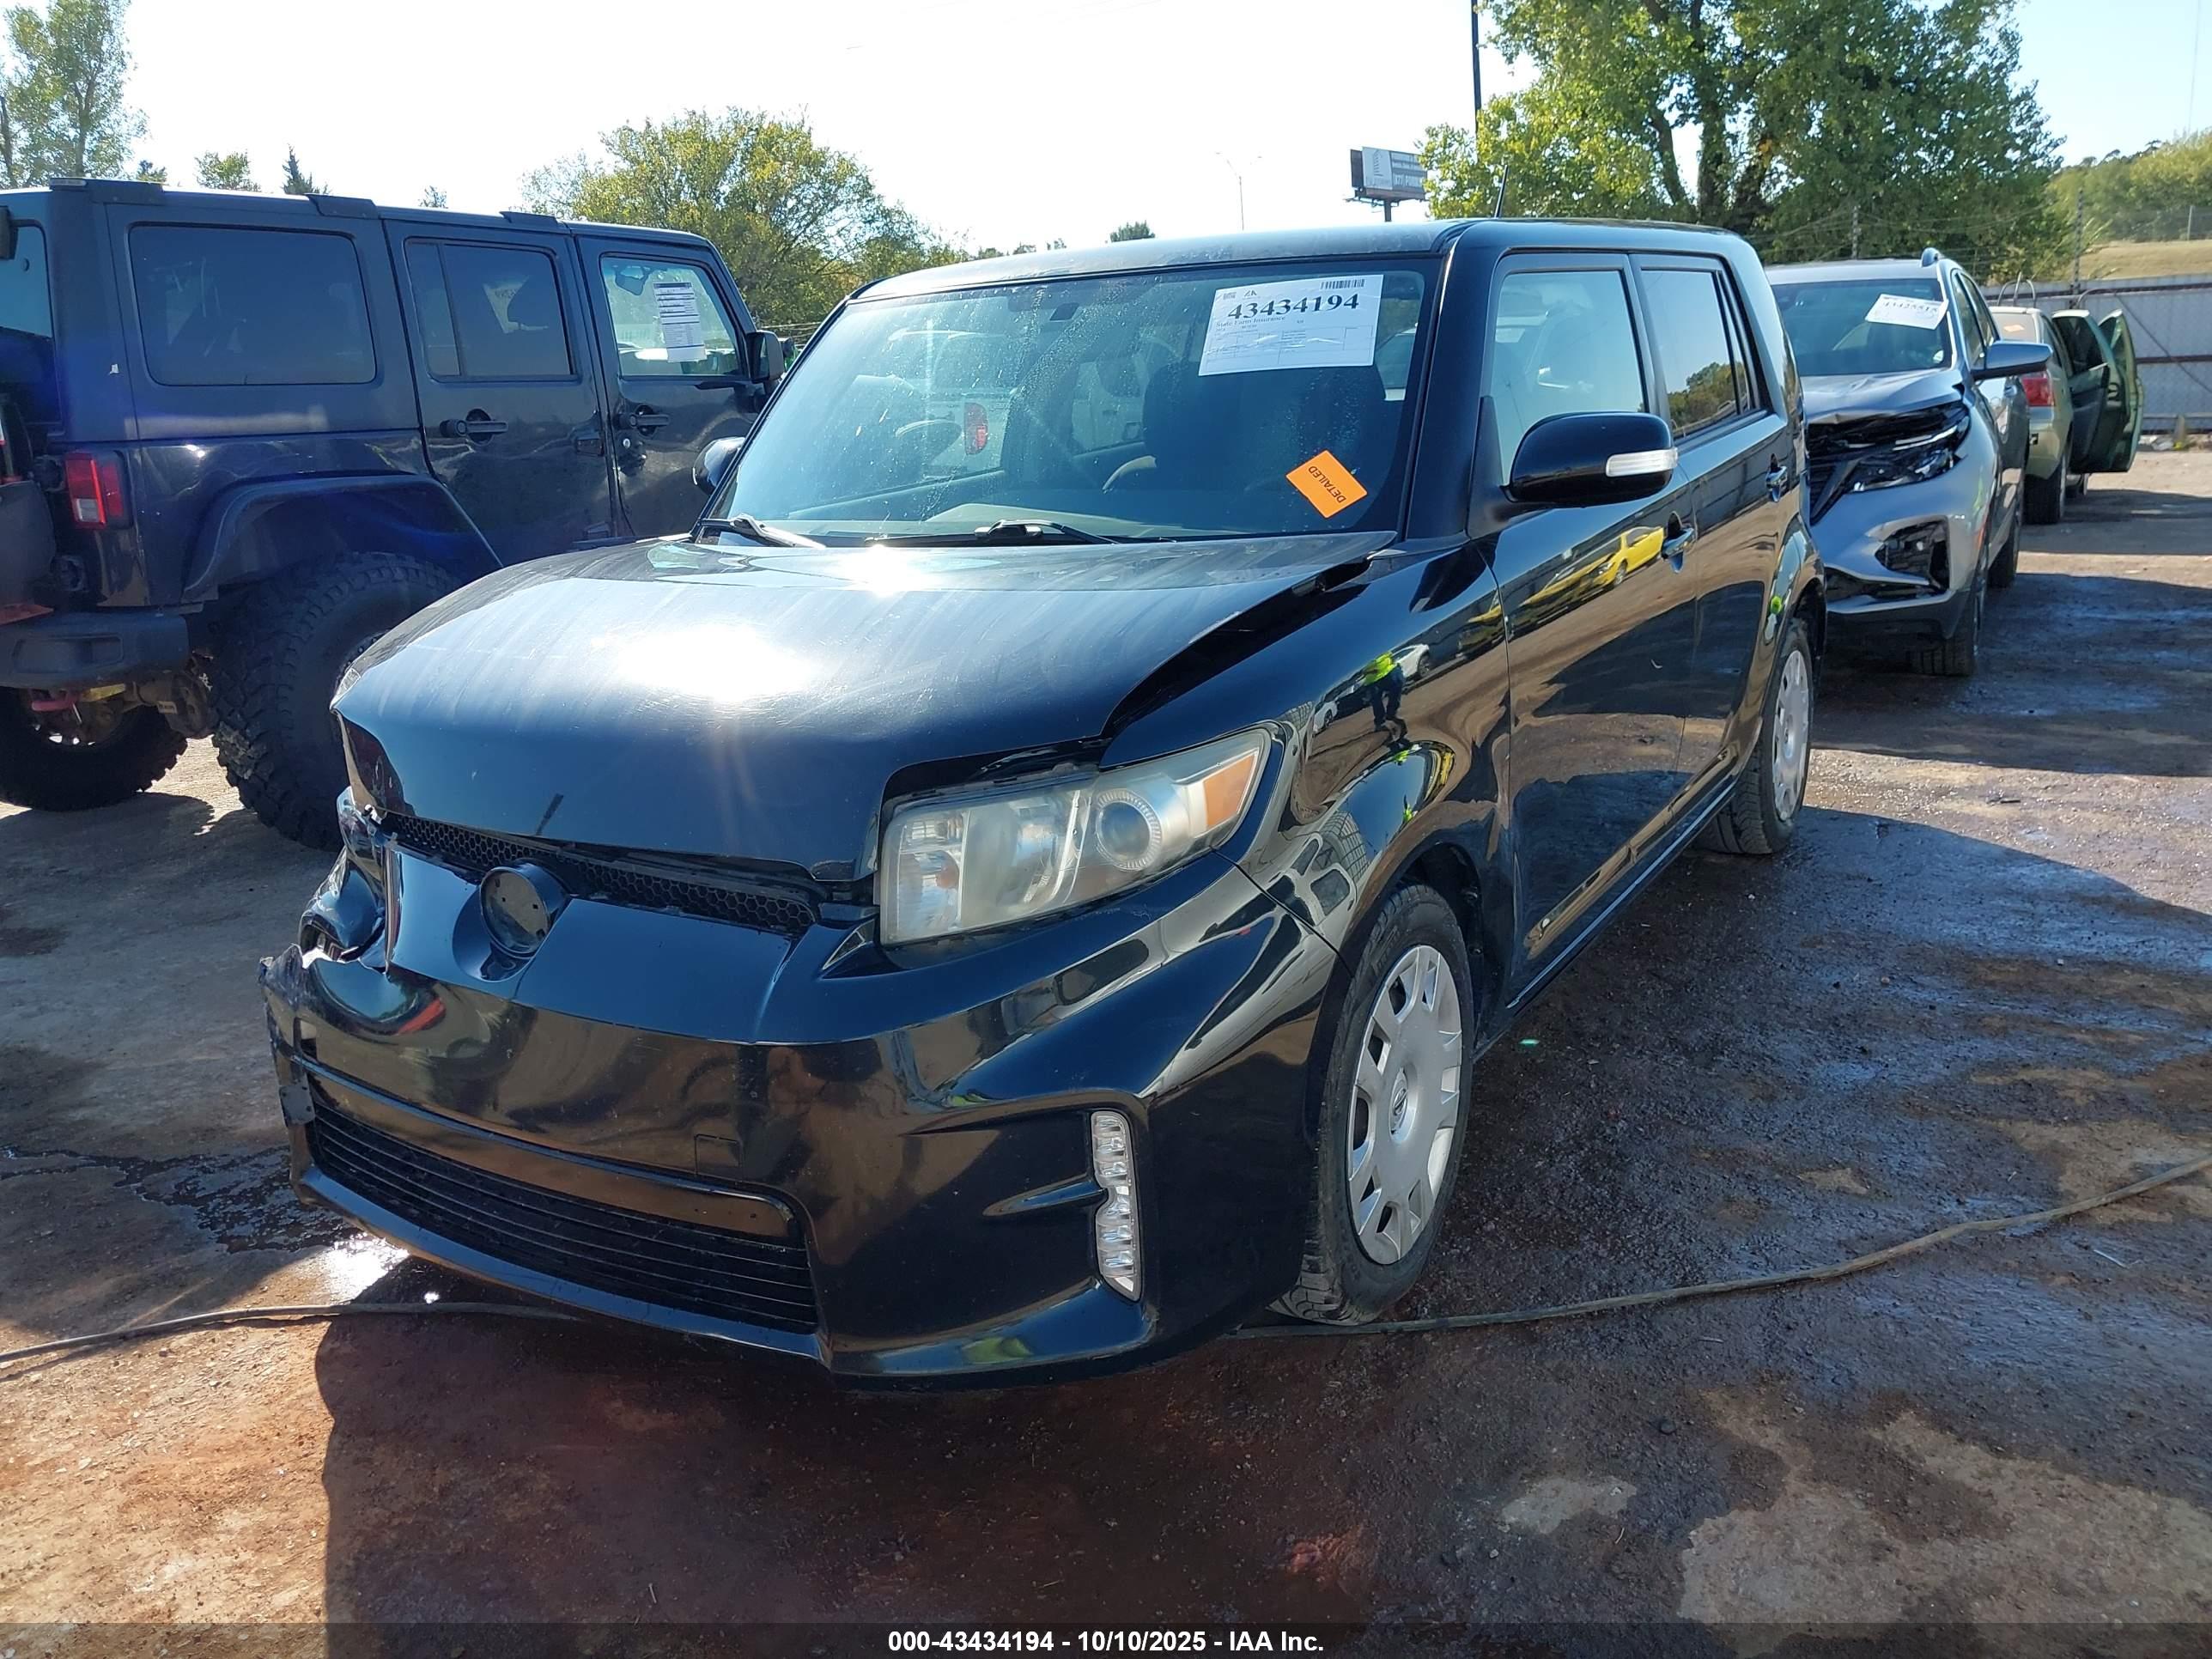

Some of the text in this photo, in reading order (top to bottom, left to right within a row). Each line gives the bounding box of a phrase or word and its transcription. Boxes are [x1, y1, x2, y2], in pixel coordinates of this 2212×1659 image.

[1227, 293, 1359, 319] 43434194
[1253, 315, 1285, 324] Insurance
[1308, 466, 1346, 503] DETAILED
